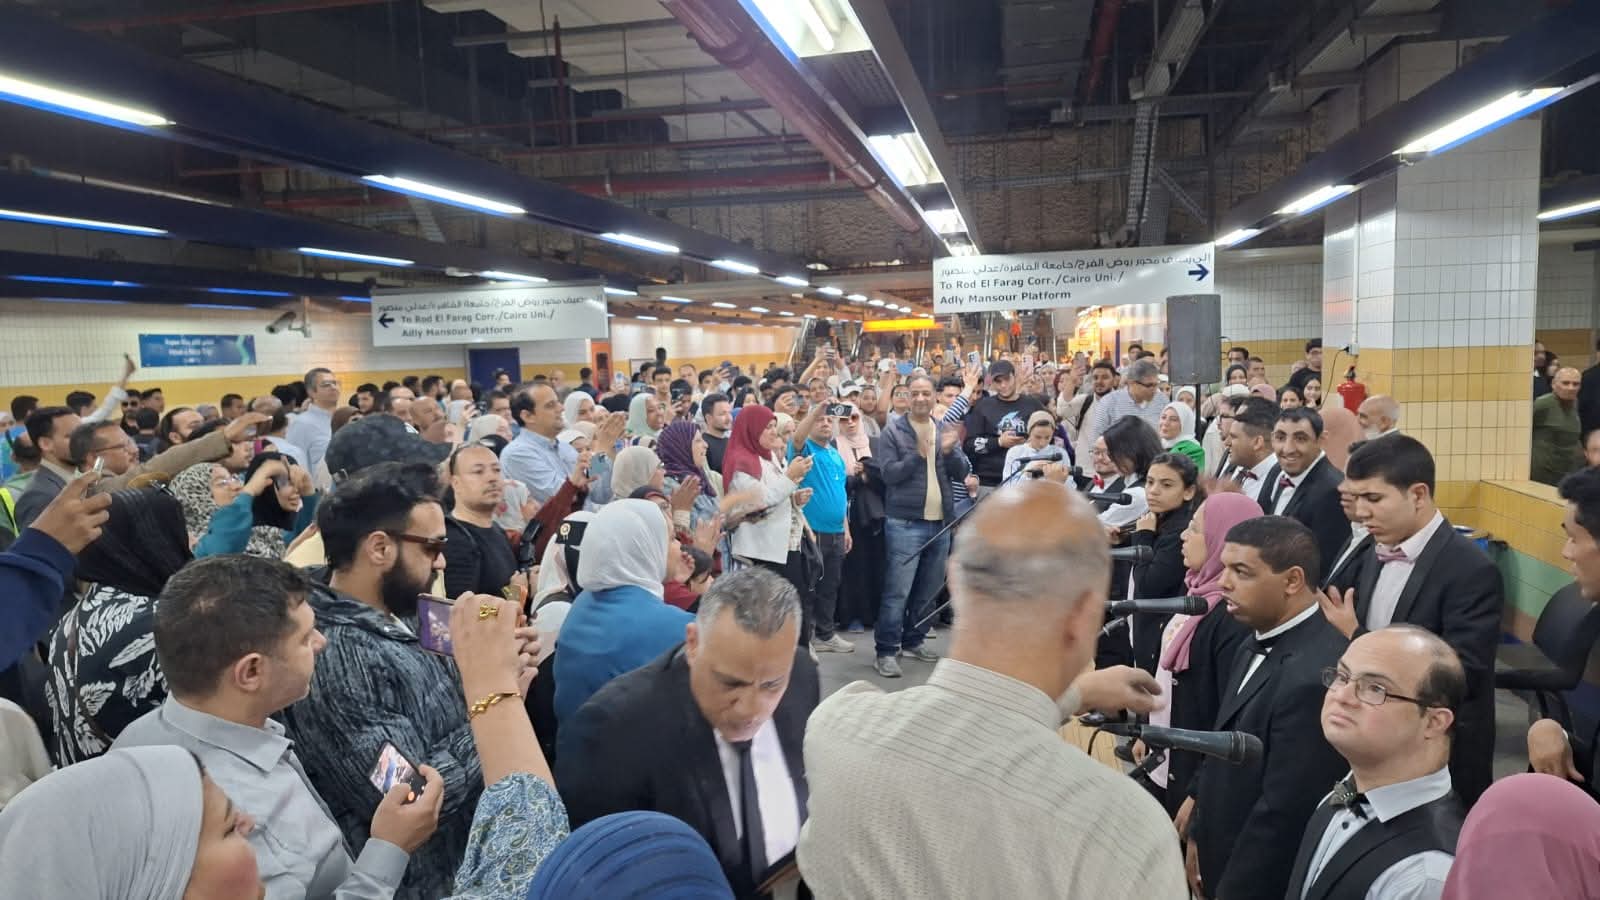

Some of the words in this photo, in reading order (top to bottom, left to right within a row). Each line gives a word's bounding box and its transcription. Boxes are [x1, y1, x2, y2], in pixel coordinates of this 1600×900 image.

[1135, 256, 1159, 267] محور
[940, 281, 952, 290] To
[956, 280, 976, 289] Rod
[981, 279, 990, 288] El
[994, 278, 1024, 289] Farag
[940, 295, 964, 305] Adly
[969, 293, 1018, 303] Mansour
[1021, 291, 1071, 301] Platform
[402, 315, 412, 324] To
[415, 314, 432, 324] Rod
[446, 313, 472, 323] Farag
[426, 327, 467, 337] Mansour
[471, 326, 513, 336] Platform
